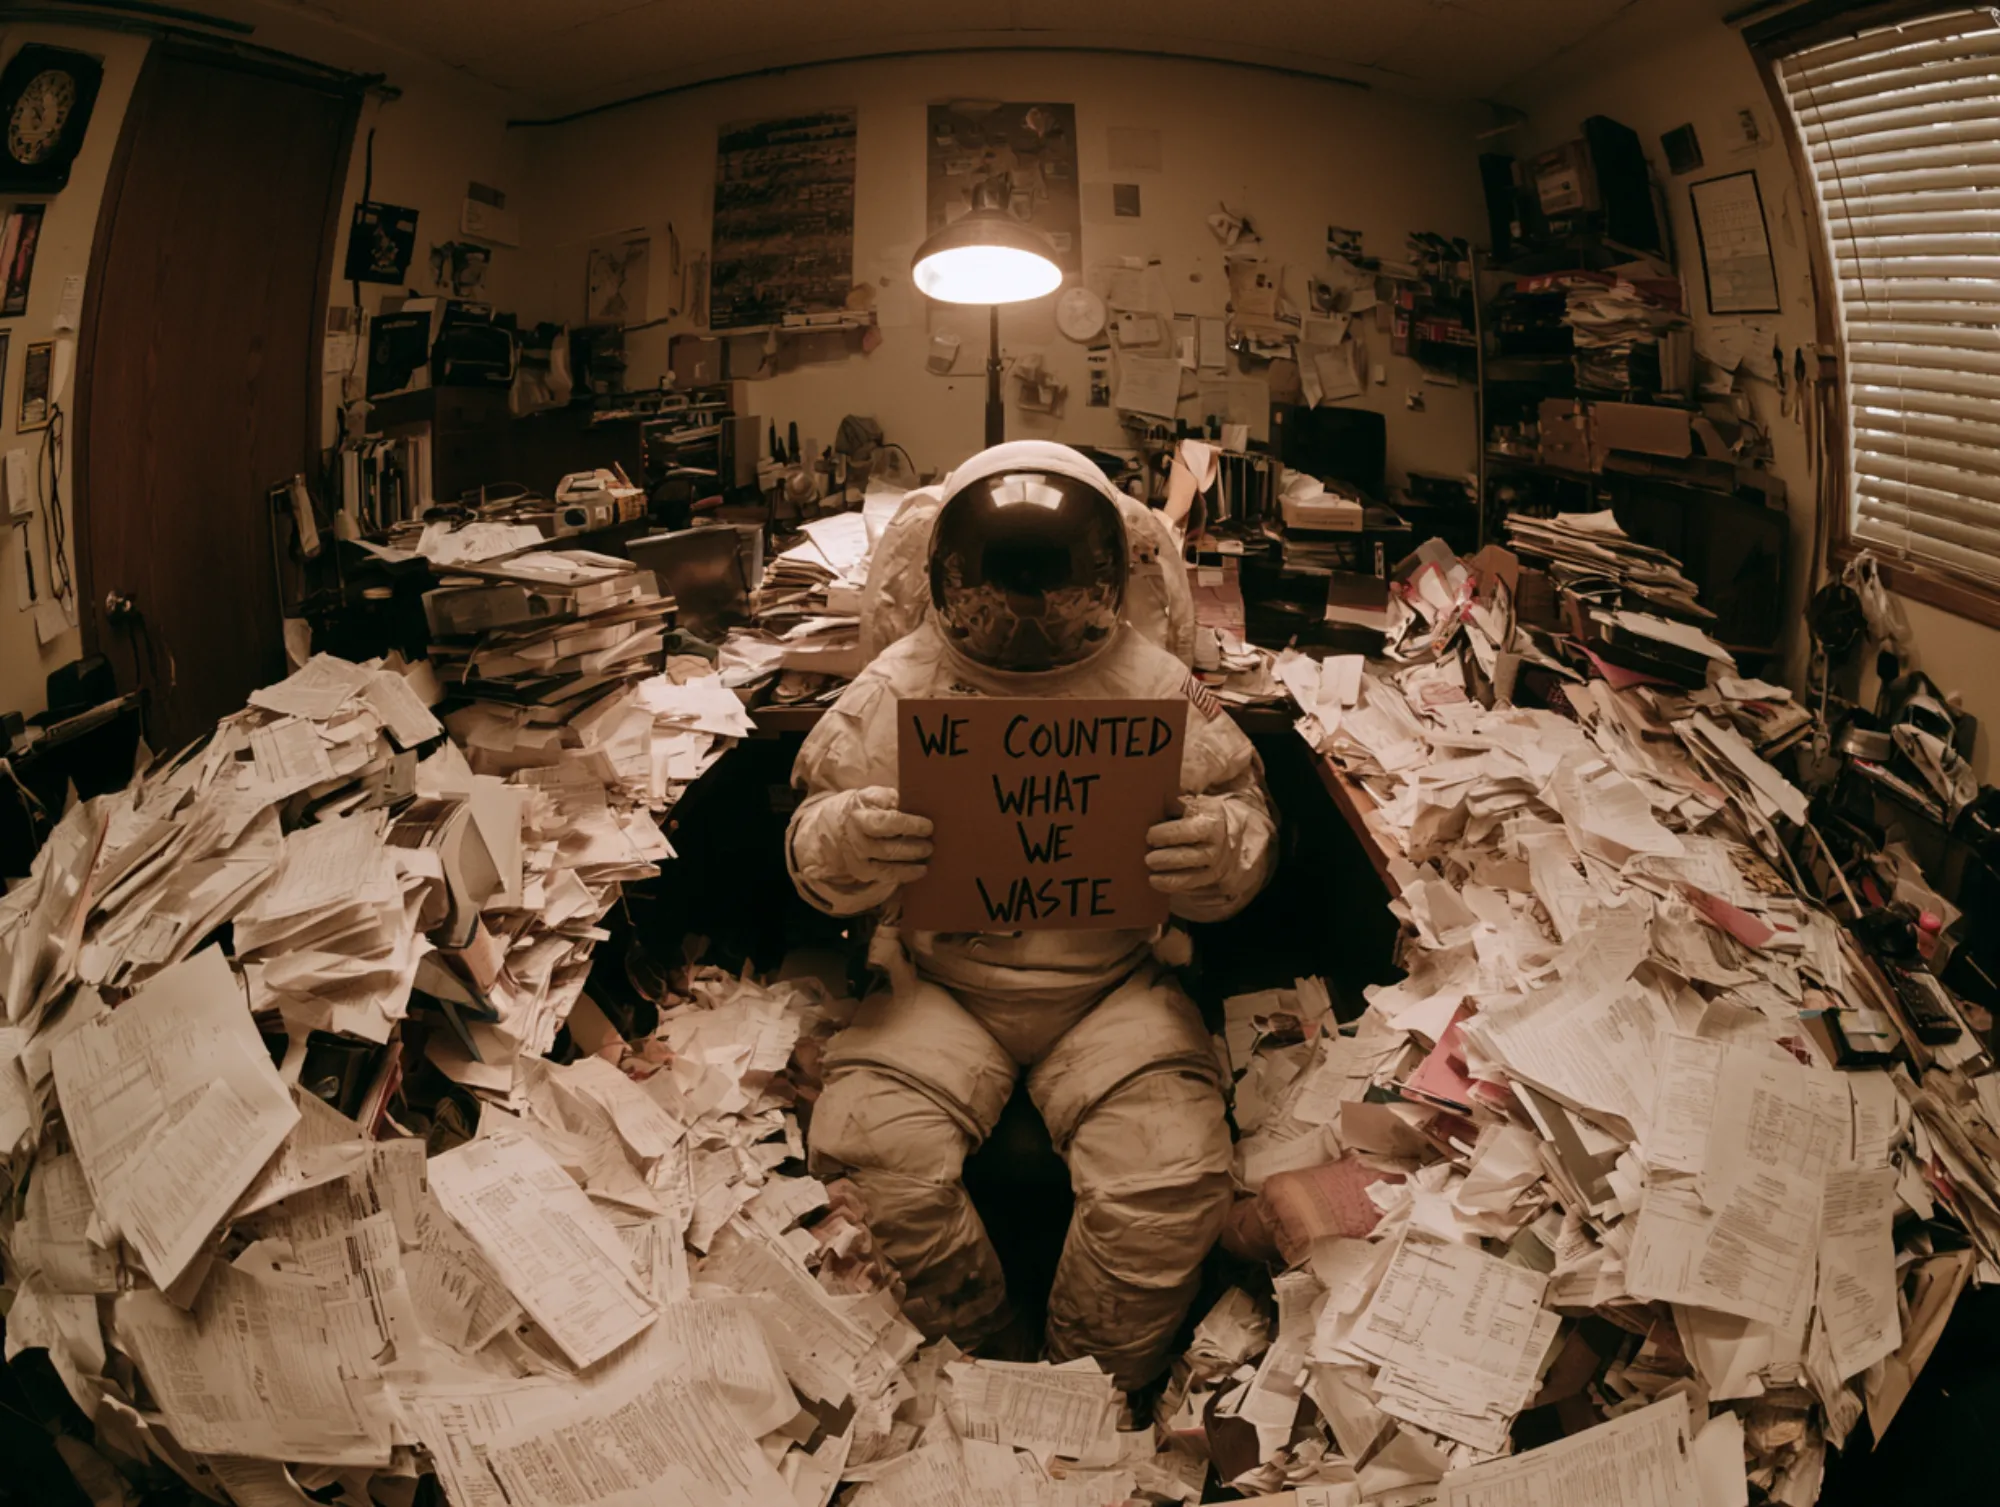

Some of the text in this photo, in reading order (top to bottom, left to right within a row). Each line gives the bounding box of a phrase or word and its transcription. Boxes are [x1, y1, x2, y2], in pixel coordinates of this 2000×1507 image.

[913, 713, 1172, 759] WE COUNTED
[992, 769, 1100, 817] WHAT
[1017, 821, 1073, 864] WE
[976, 877, 1115, 923] WASTE
